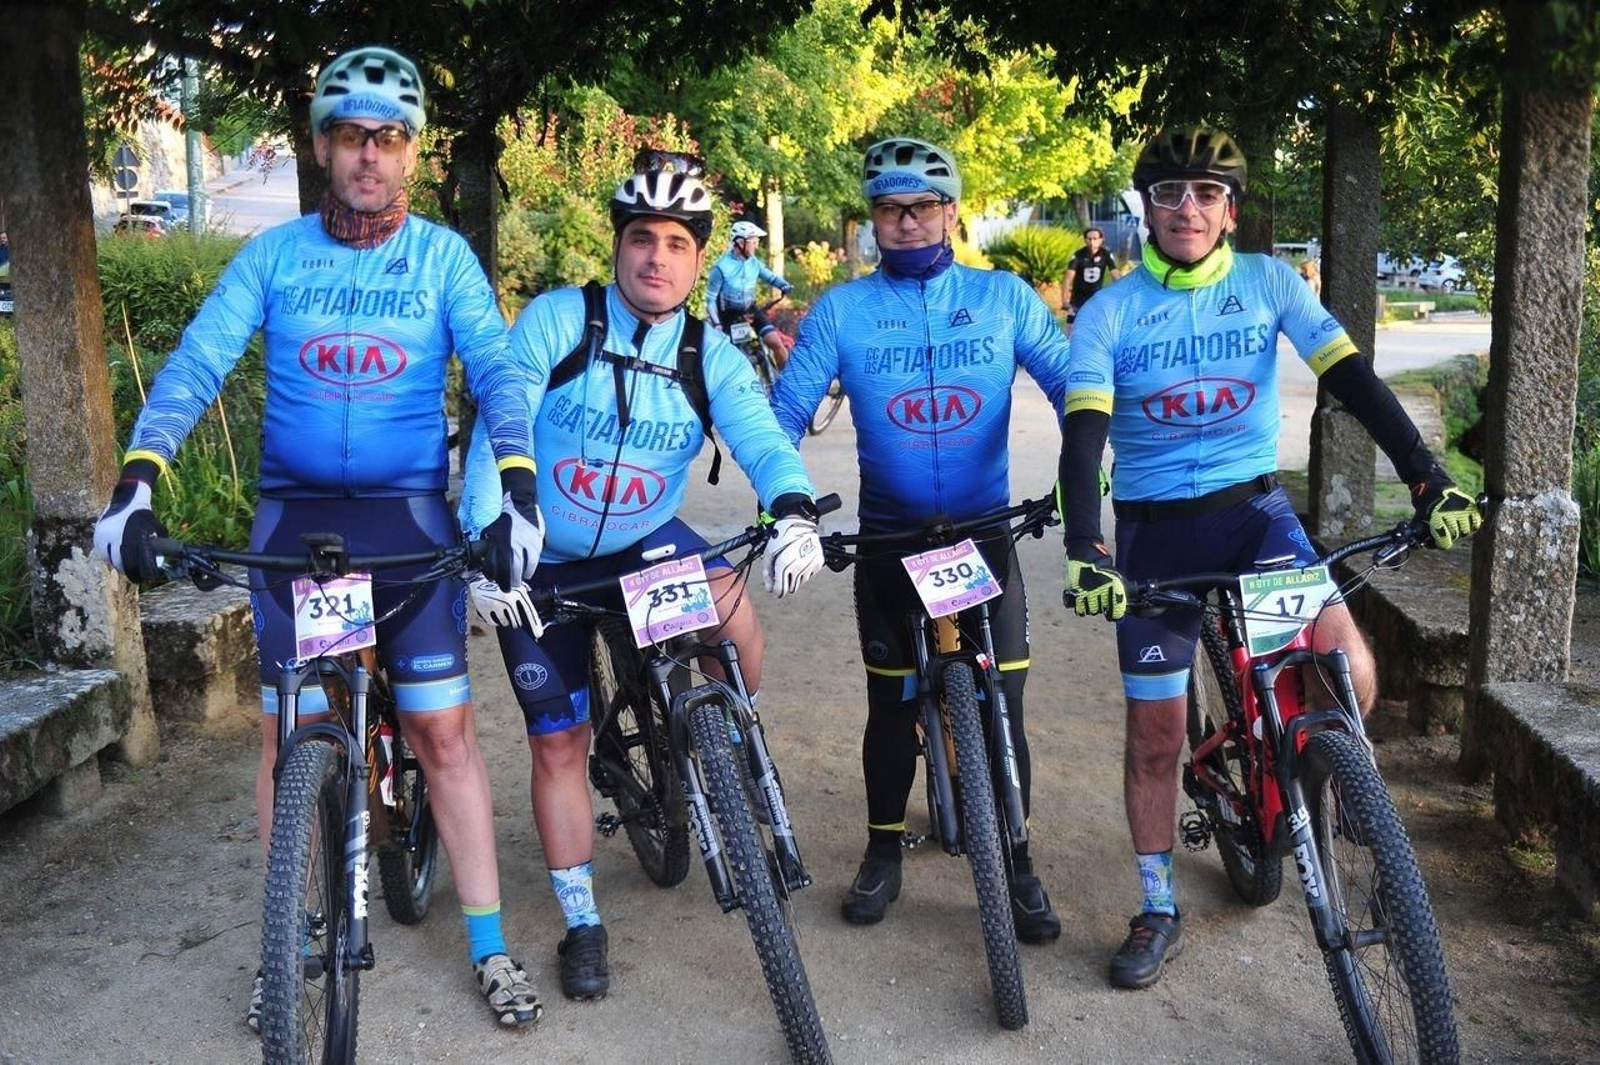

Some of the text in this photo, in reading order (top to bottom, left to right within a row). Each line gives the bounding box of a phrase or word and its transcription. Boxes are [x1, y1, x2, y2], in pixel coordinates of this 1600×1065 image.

[293, 286, 428, 320] AFIADORES
[317, 344, 388, 374] KIA
[878, 335, 995, 374] AFIADORES
[1130, 322, 1270, 374] AFIADORES
[902, 393, 967, 425] KIA
[1160, 386, 1241, 420] KIA
[569, 464, 648, 505] KIA
[929, 562, 973, 588] 330
[308, 593, 356, 620] 321
[646, 581, 693, 608] 331
[1275, 594, 1305, 618] 17
[1293, 842, 1320, 899] FOX
